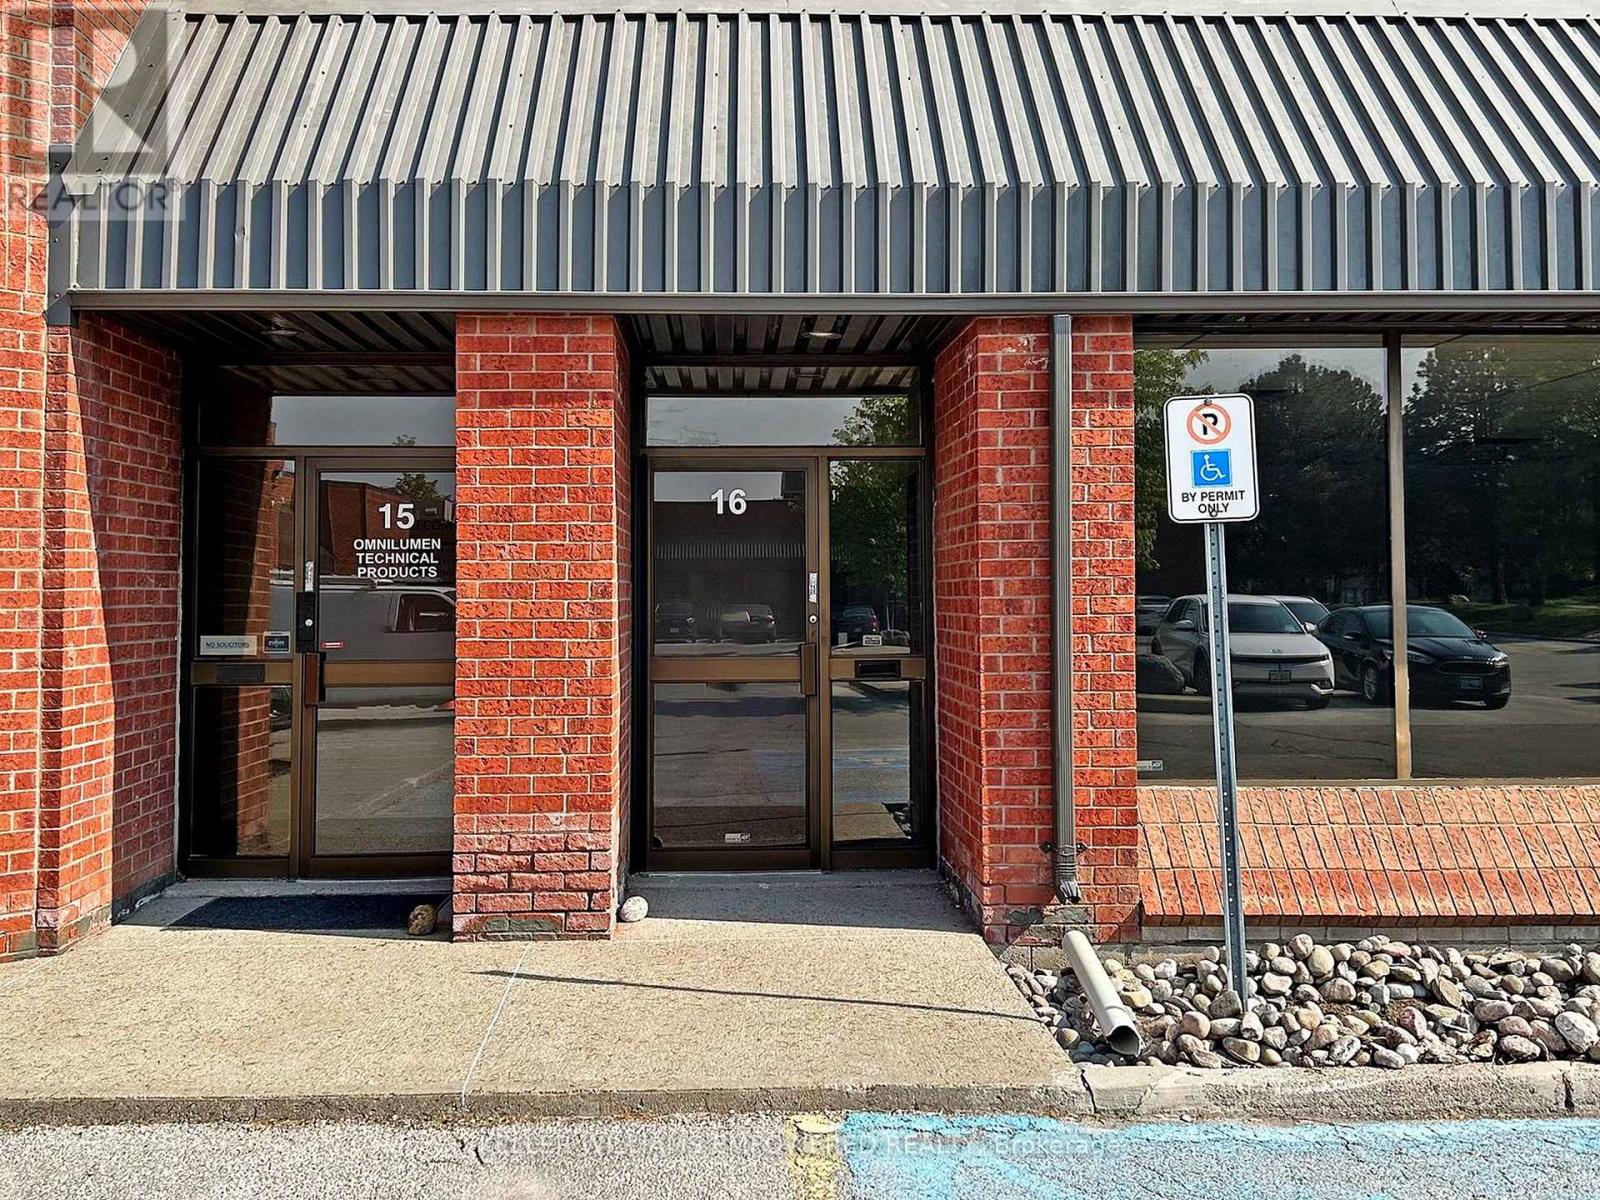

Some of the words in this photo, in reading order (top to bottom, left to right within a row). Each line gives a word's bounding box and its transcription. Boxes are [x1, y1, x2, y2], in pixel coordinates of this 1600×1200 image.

[710, 488, 747, 515] 16
[1181, 491, 1200, 502] BY
[1200, 490, 1245, 502] PERMIT
[1198, 503, 1230, 514] ONLY
[378, 503, 415, 530] 15
[353, 538, 441, 550] OMNILUMEN
[356, 552, 439, 564] TECHNICAL
[357, 566, 438, 578] PRODUCTS
[205, 640, 216, 649] NO
